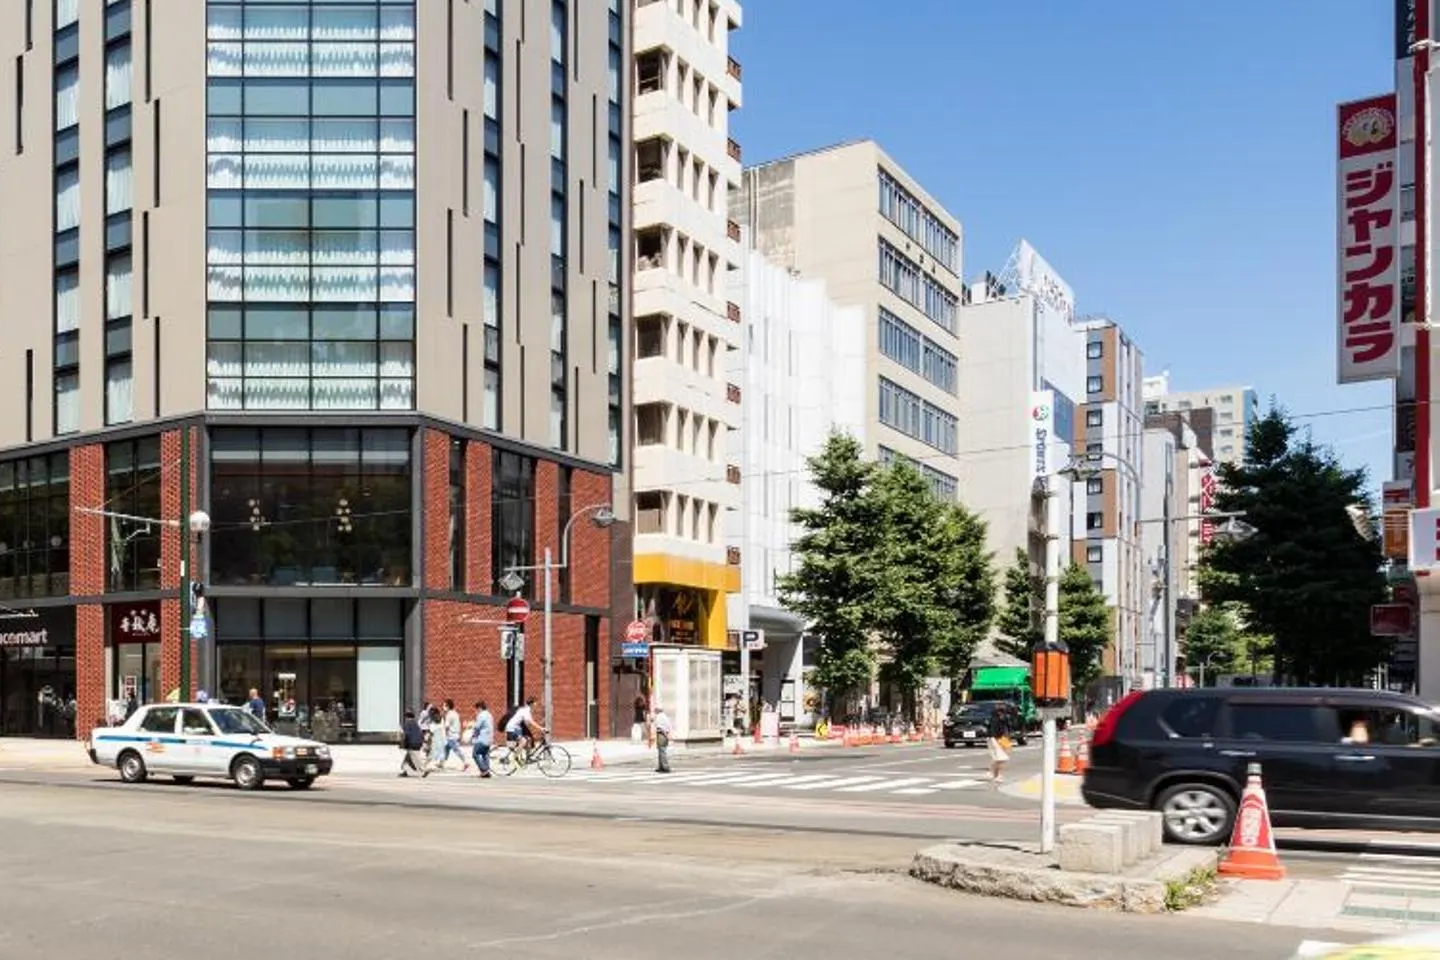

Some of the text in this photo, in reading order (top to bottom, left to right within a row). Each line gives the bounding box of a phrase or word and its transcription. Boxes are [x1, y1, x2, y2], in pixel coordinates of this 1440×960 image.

[1344, 161, 1394, 363] ジャンカラ
[742, 631, 760, 648] P
